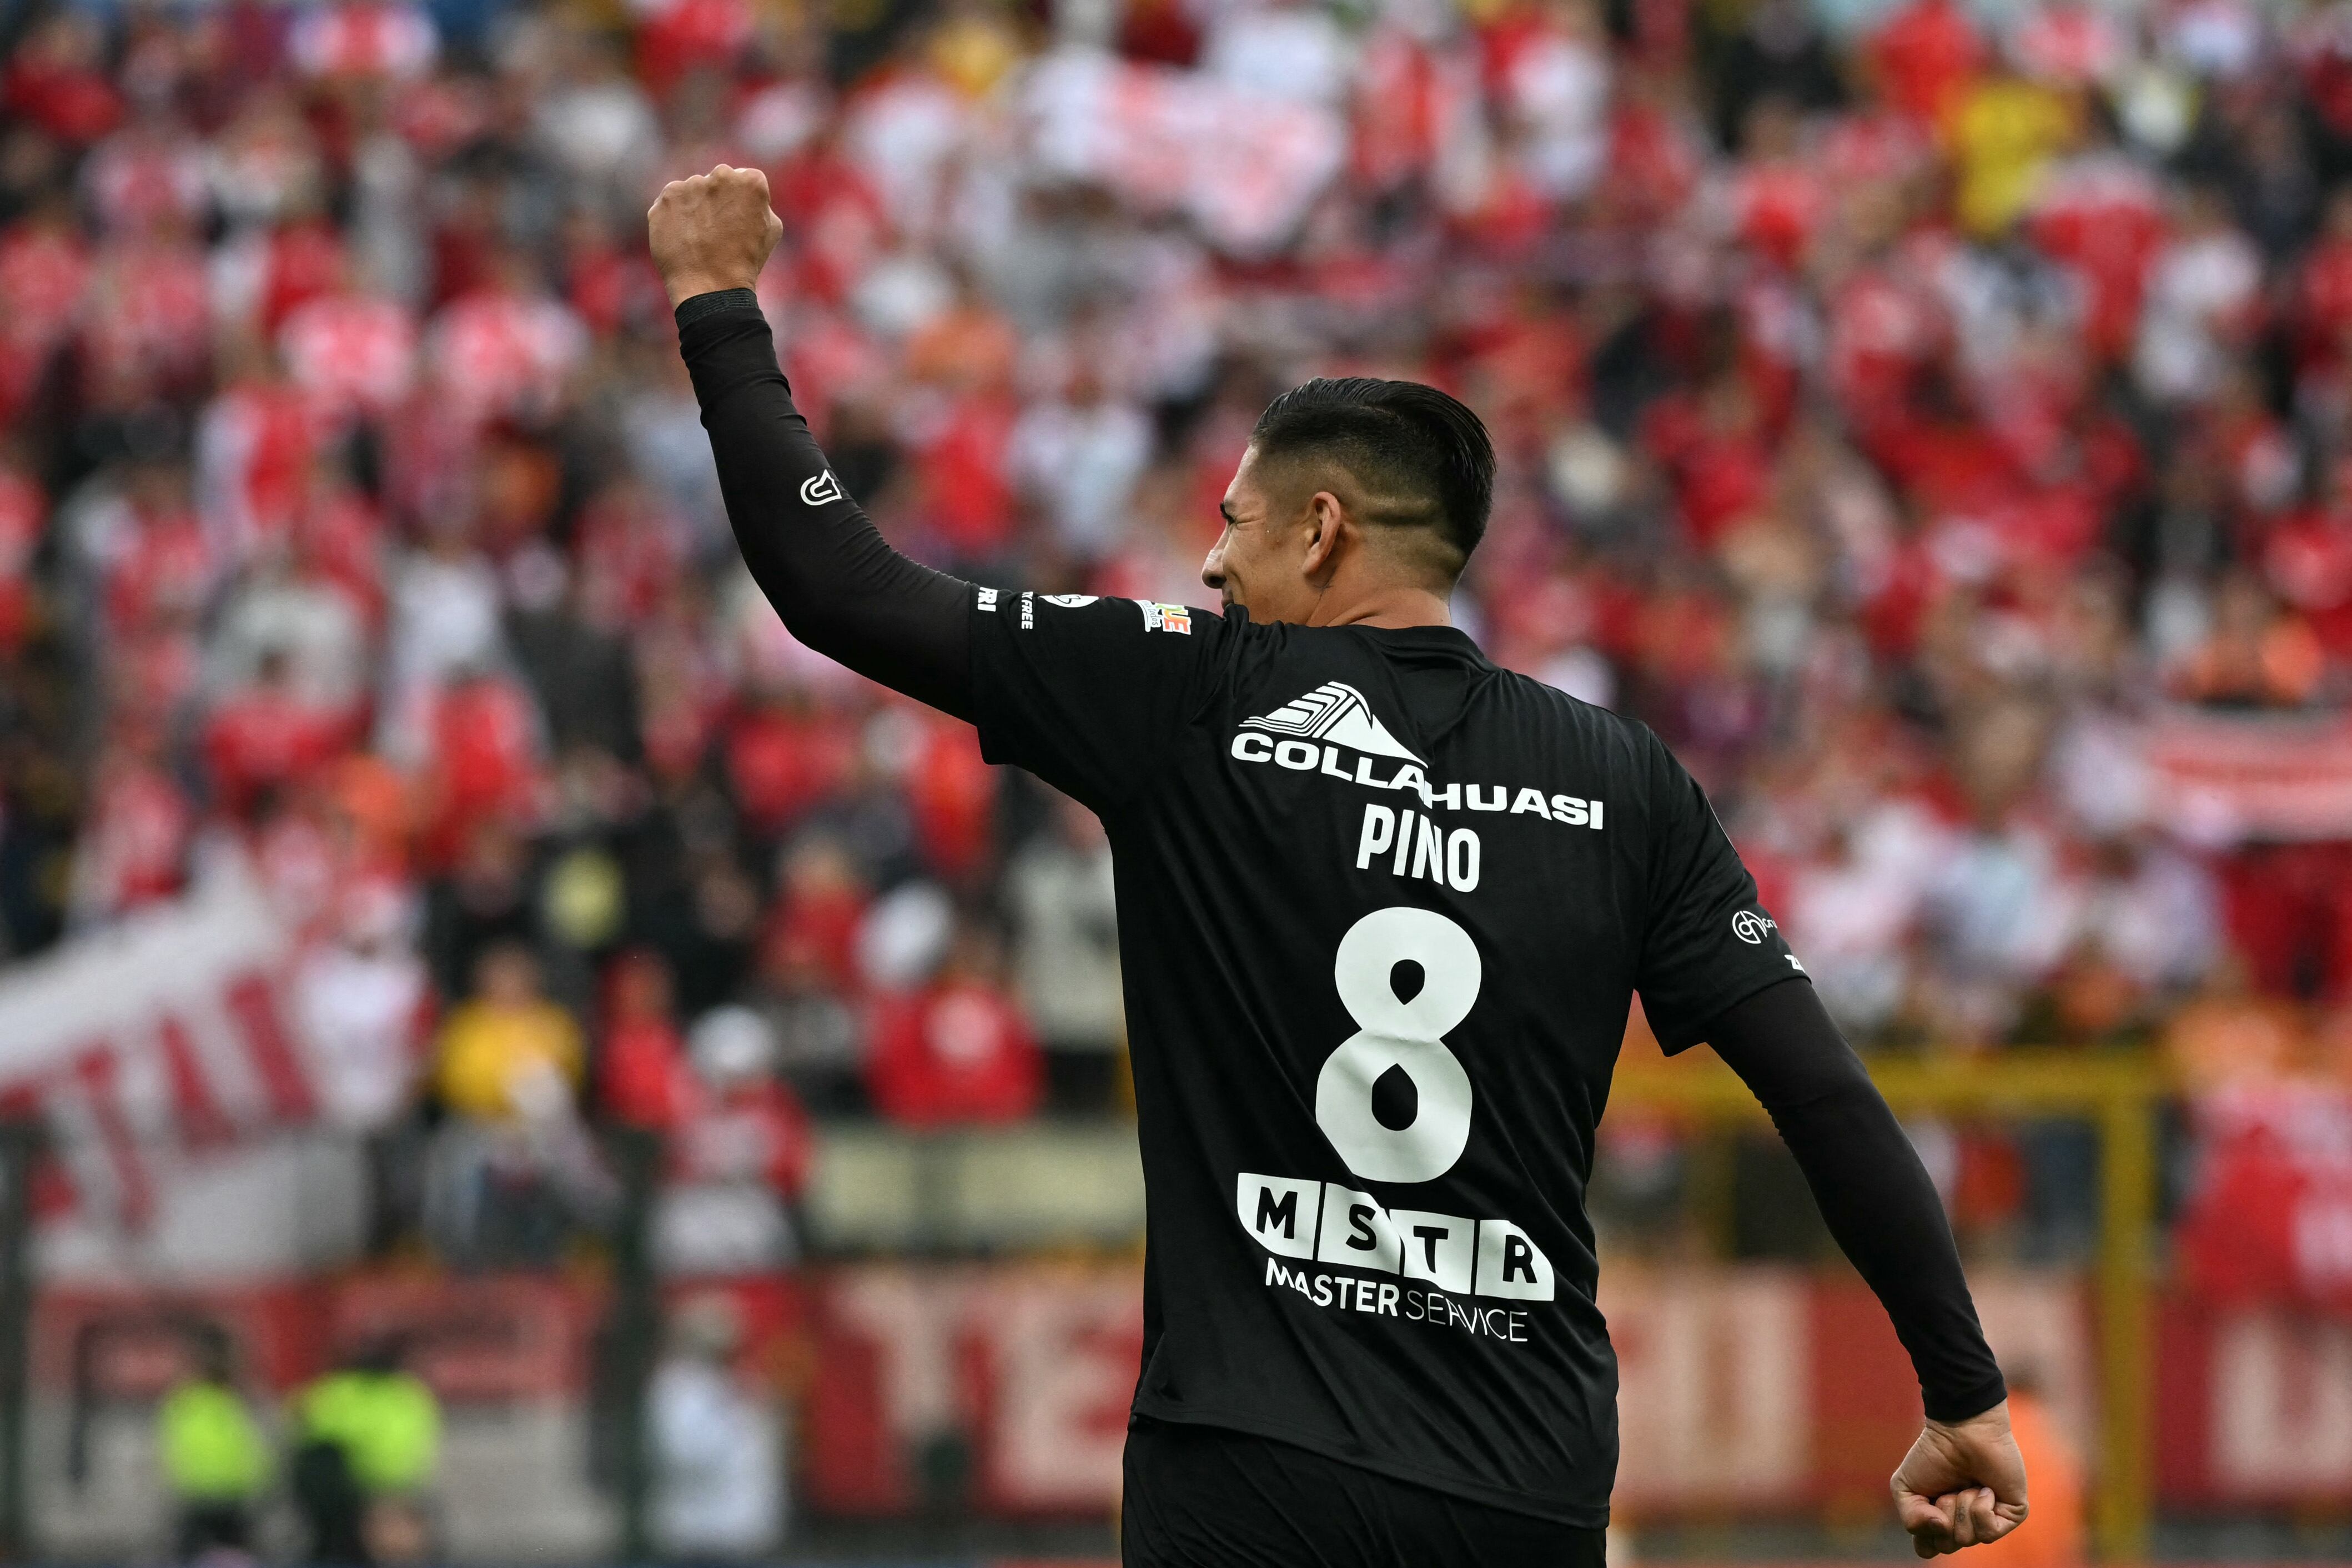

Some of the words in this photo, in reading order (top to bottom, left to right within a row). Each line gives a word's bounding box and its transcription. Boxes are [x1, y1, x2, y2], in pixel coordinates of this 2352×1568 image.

[1021, 600, 1033, 630] FREE
[1230, 732, 1604, 830] COLLAHUASI
[1356, 803, 1480, 893] PINO
[1315, 906, 1482, 1183] 8
[1256, 1185, 1538, 1284] MSTR
[1265, 1257, 1400, 1316] MASTER
[1405, 1290, 1528, 1342] SERVICE
